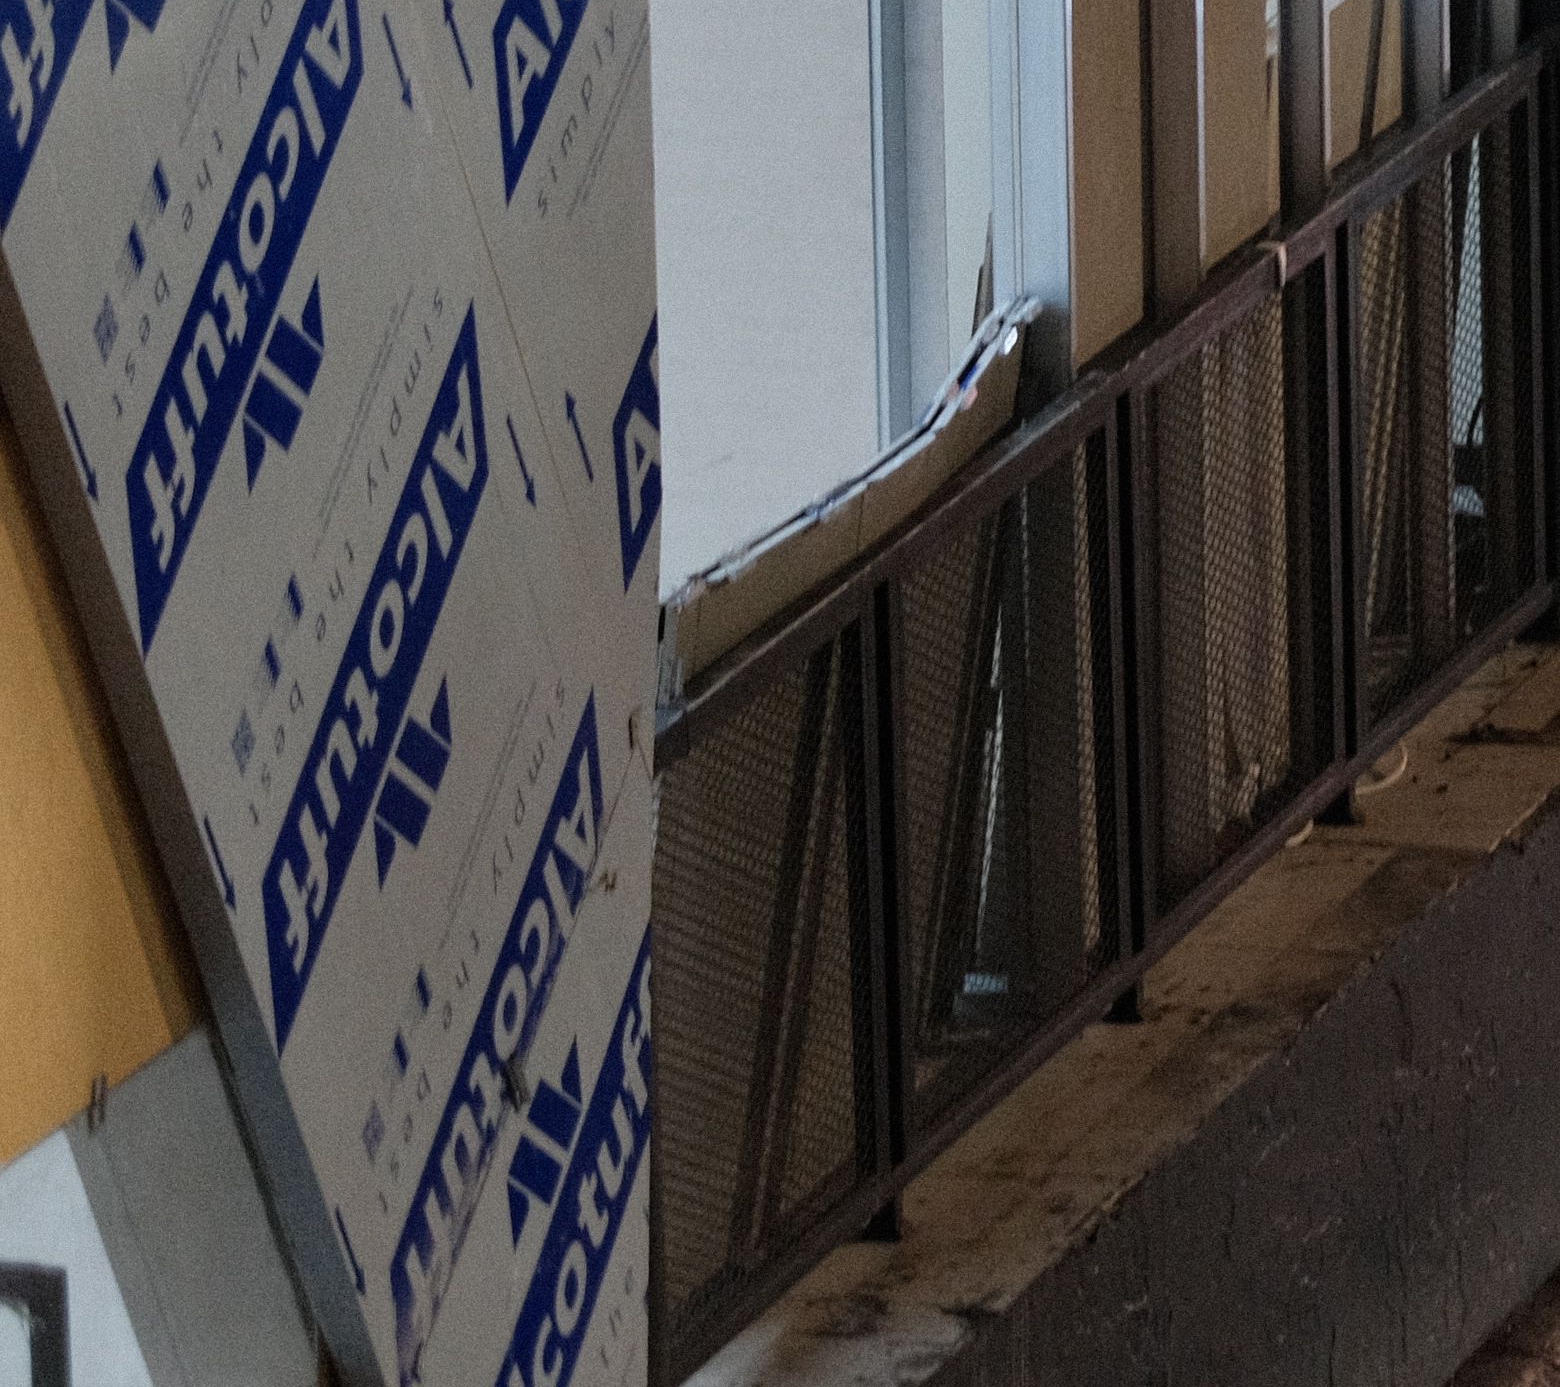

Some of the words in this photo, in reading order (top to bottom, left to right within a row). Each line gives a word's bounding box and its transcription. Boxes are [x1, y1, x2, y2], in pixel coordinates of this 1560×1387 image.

[180, 128, 224, 231] the
[111, 270, 170, 420] best
[277, 362, 477, 974] Alcotuff
[248, 680, 305, 826] best
